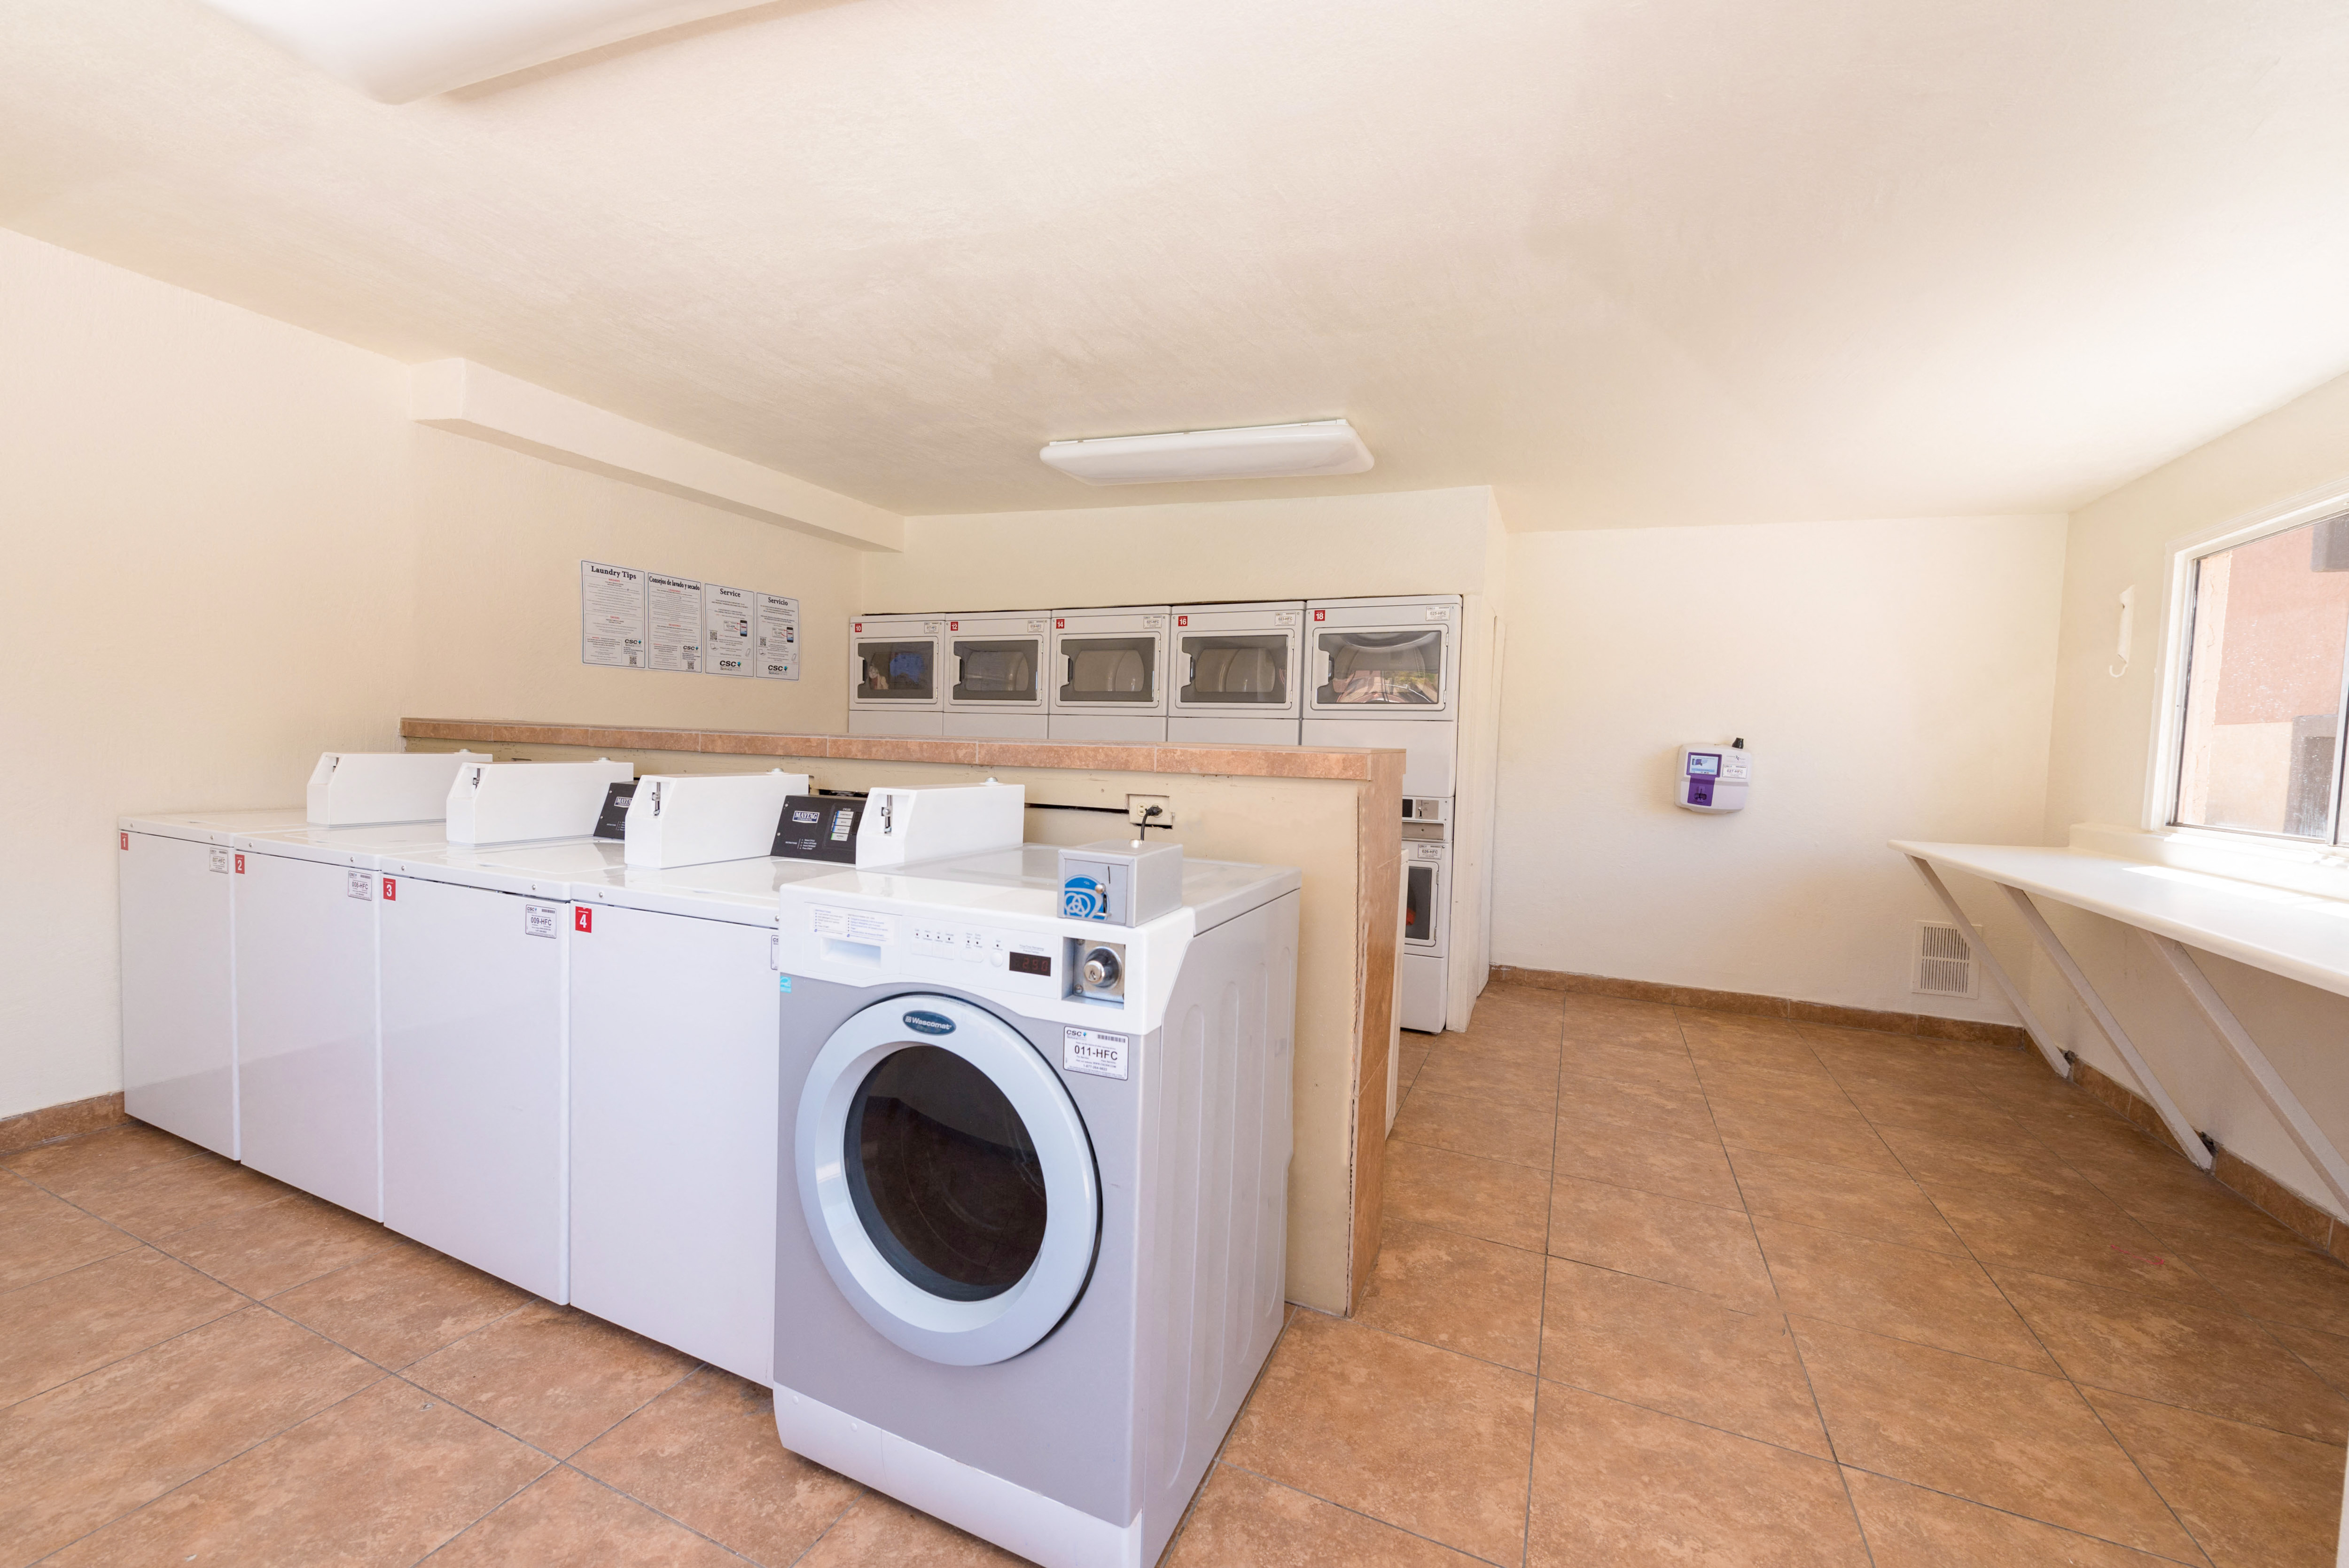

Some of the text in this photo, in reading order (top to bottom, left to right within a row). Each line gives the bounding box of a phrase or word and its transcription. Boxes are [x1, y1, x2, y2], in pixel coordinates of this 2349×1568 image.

[591, 565, 636, 580] Laundry Tips
[649, 576, 666, 585] Consejos
[720, 588, 741, 597] Service
[768, 597, 788, 606] Servicio
[123, 837, 125, 847] 1
[238, 859, 242, 871] 2
[387, 884, 392, 897] 3
[531, 917, 552, 926] 009-HFC
[579, 914, 587, 928] 4
[912, 1016, 950, 1030] Wascomat
[1075, 1045, 1117, 1060] 011-HFC
